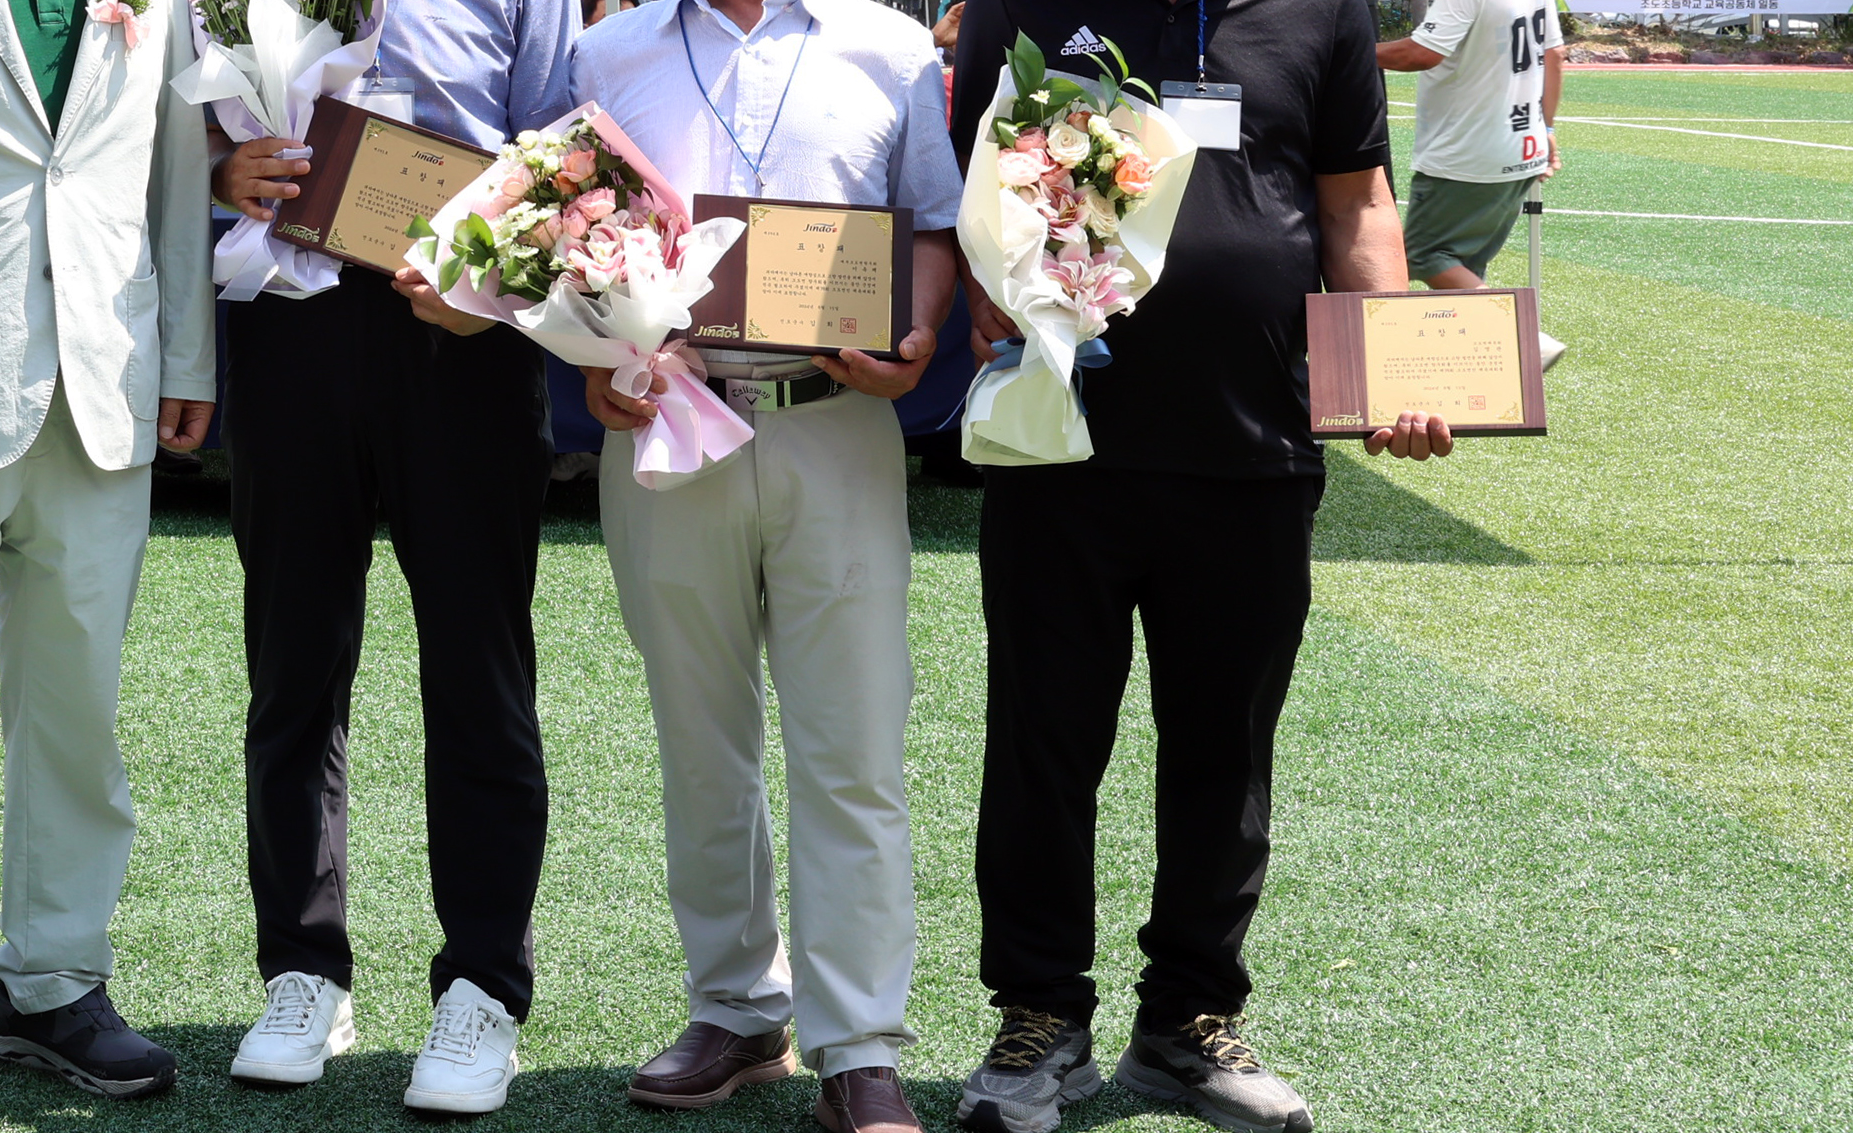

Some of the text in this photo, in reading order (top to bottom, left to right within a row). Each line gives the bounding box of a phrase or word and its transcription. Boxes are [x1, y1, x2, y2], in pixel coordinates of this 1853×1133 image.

[1060, 42, 1107, 56] adidas
[411, 150, 444, 165] Jindo
[277, 222, 320, 242] Jindo
[803, 221, 836, 234] Jindo
[1421, 307, 1456, 320] Jindo
[695, 323, 738, 339] Jindo
[731, 385, 771, 400] Callaway
[1317, 411, 1361, 427] Jindo
